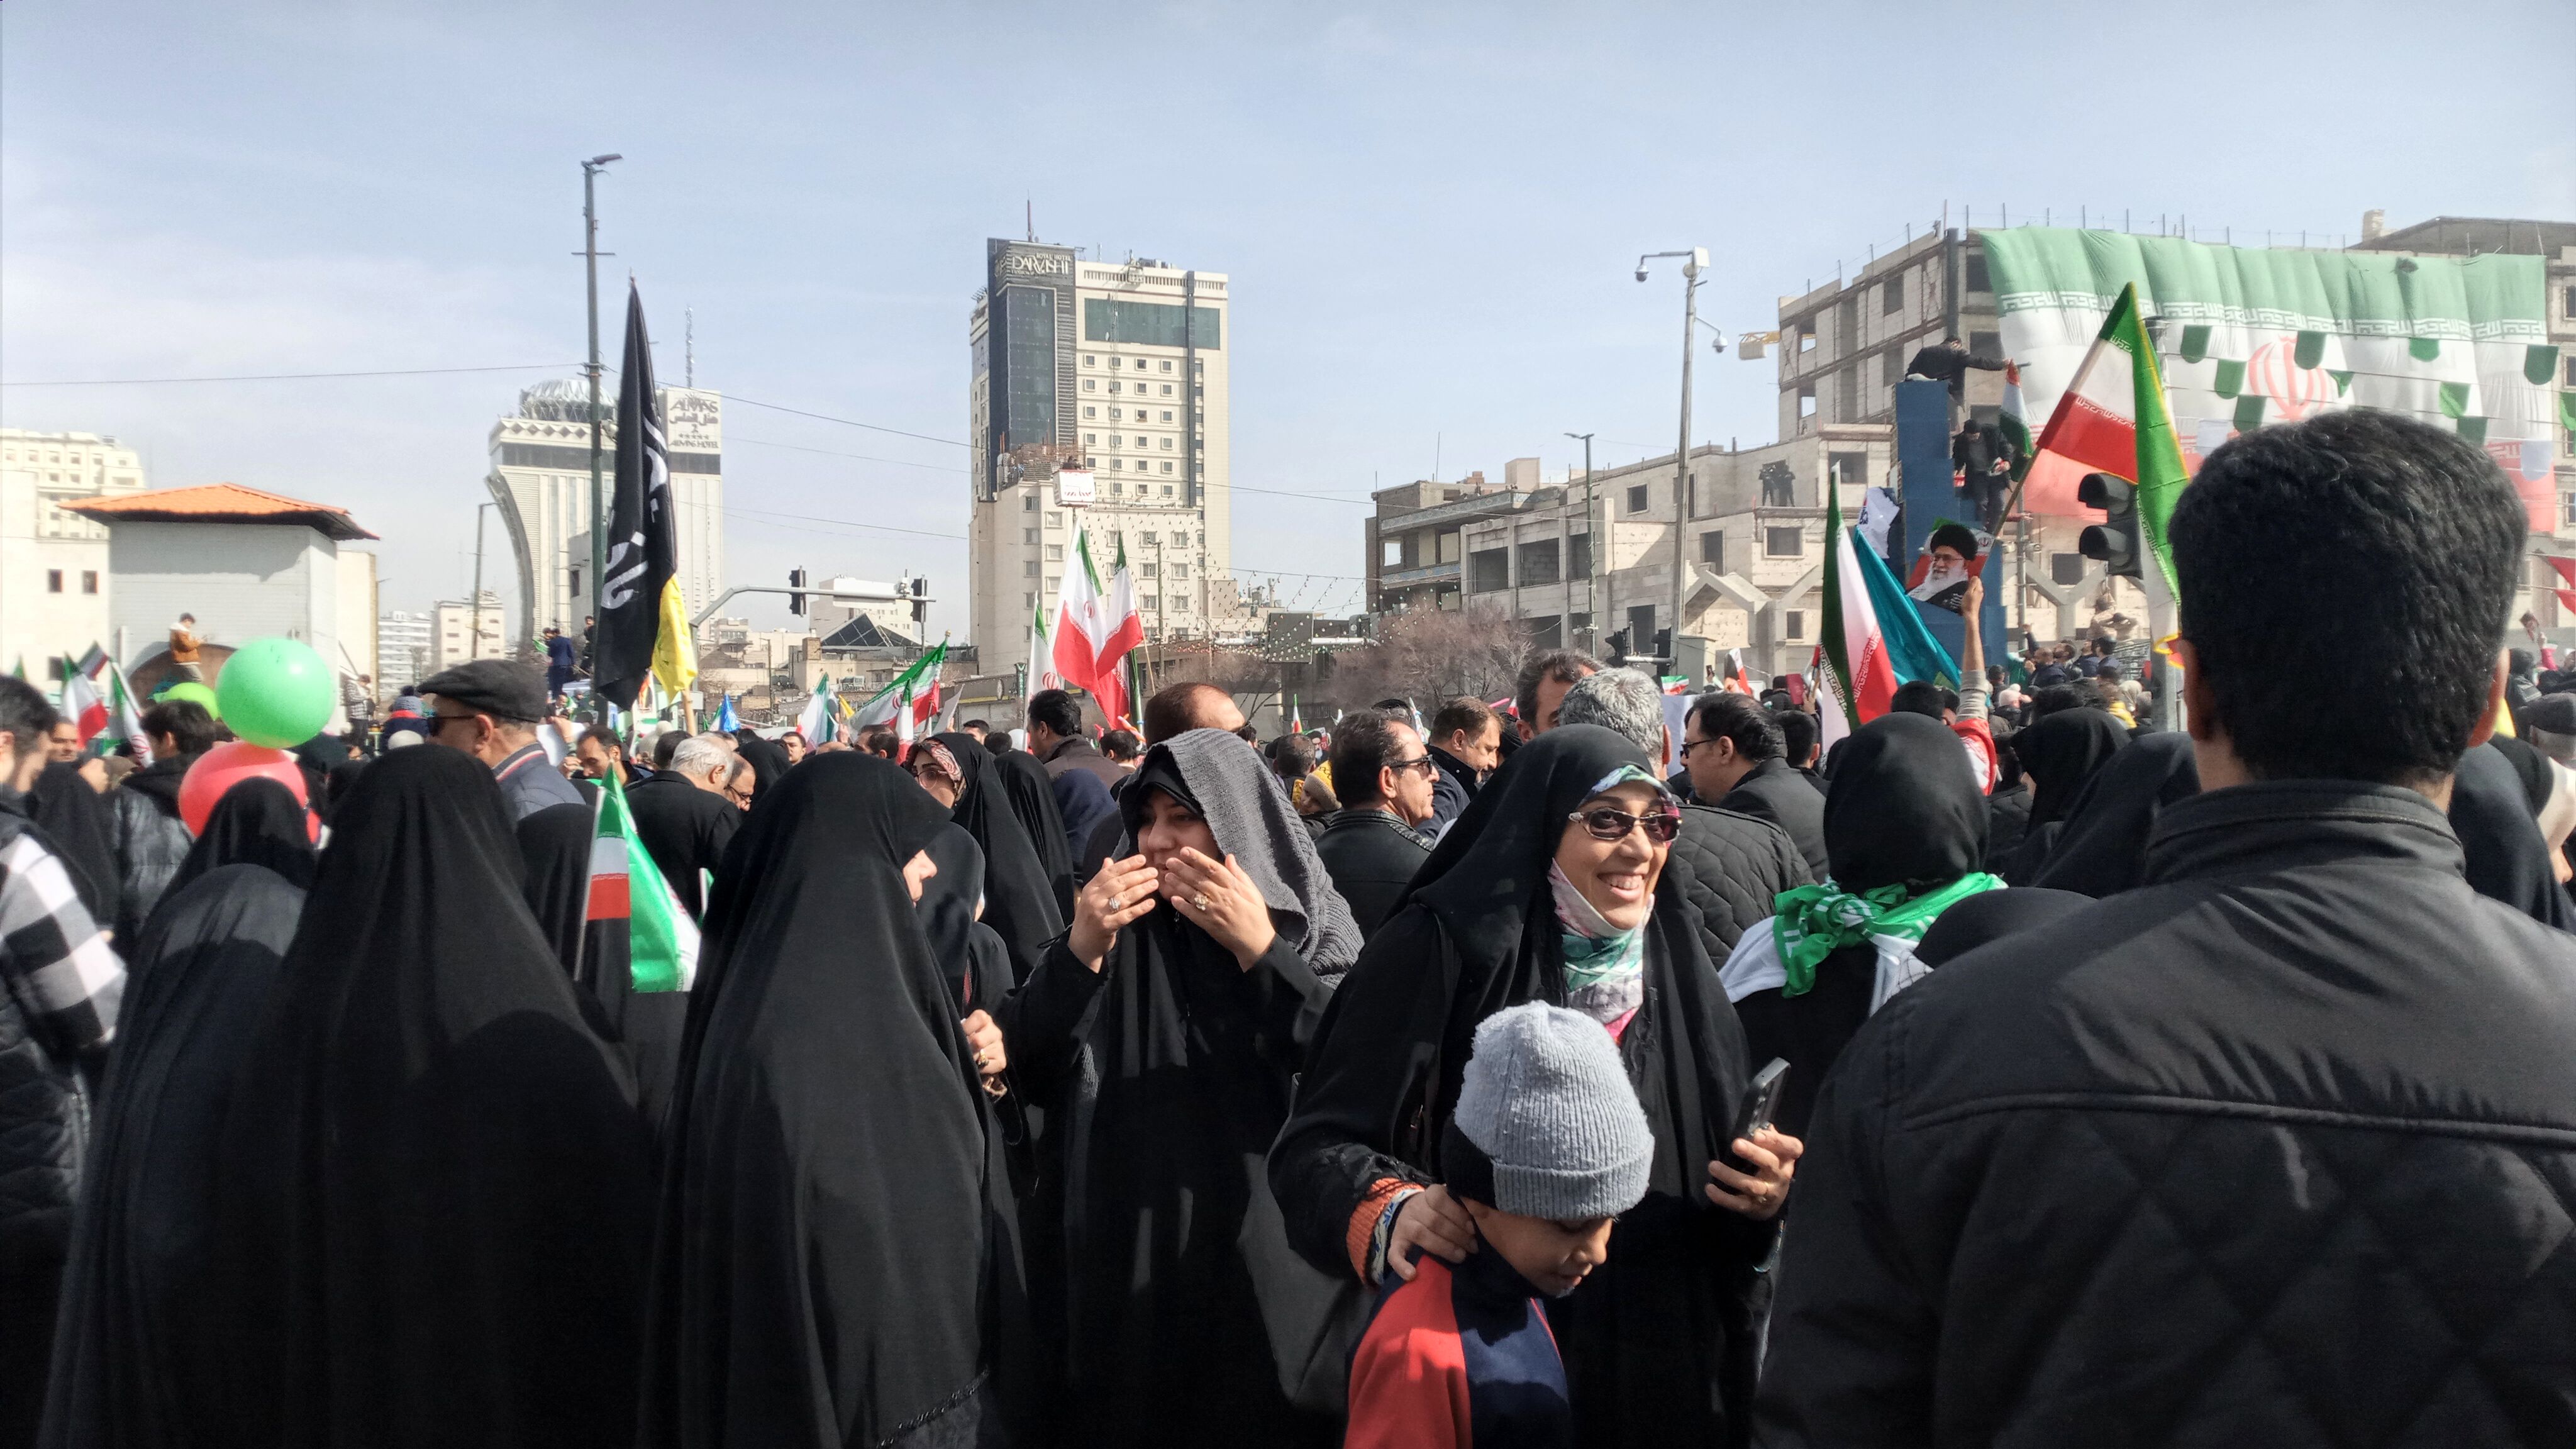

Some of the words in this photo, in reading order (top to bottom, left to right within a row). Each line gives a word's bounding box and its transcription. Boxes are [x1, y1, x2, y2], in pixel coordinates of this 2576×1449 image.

[1054, 253, 1072, 262] HOTEL
[1011, 255, 1069, 275] DARVISHI
[669, 397, 718, 413] ALMAS
[669, 413, 698, 424] الماس
[698, 413, 718, 426] هتل
